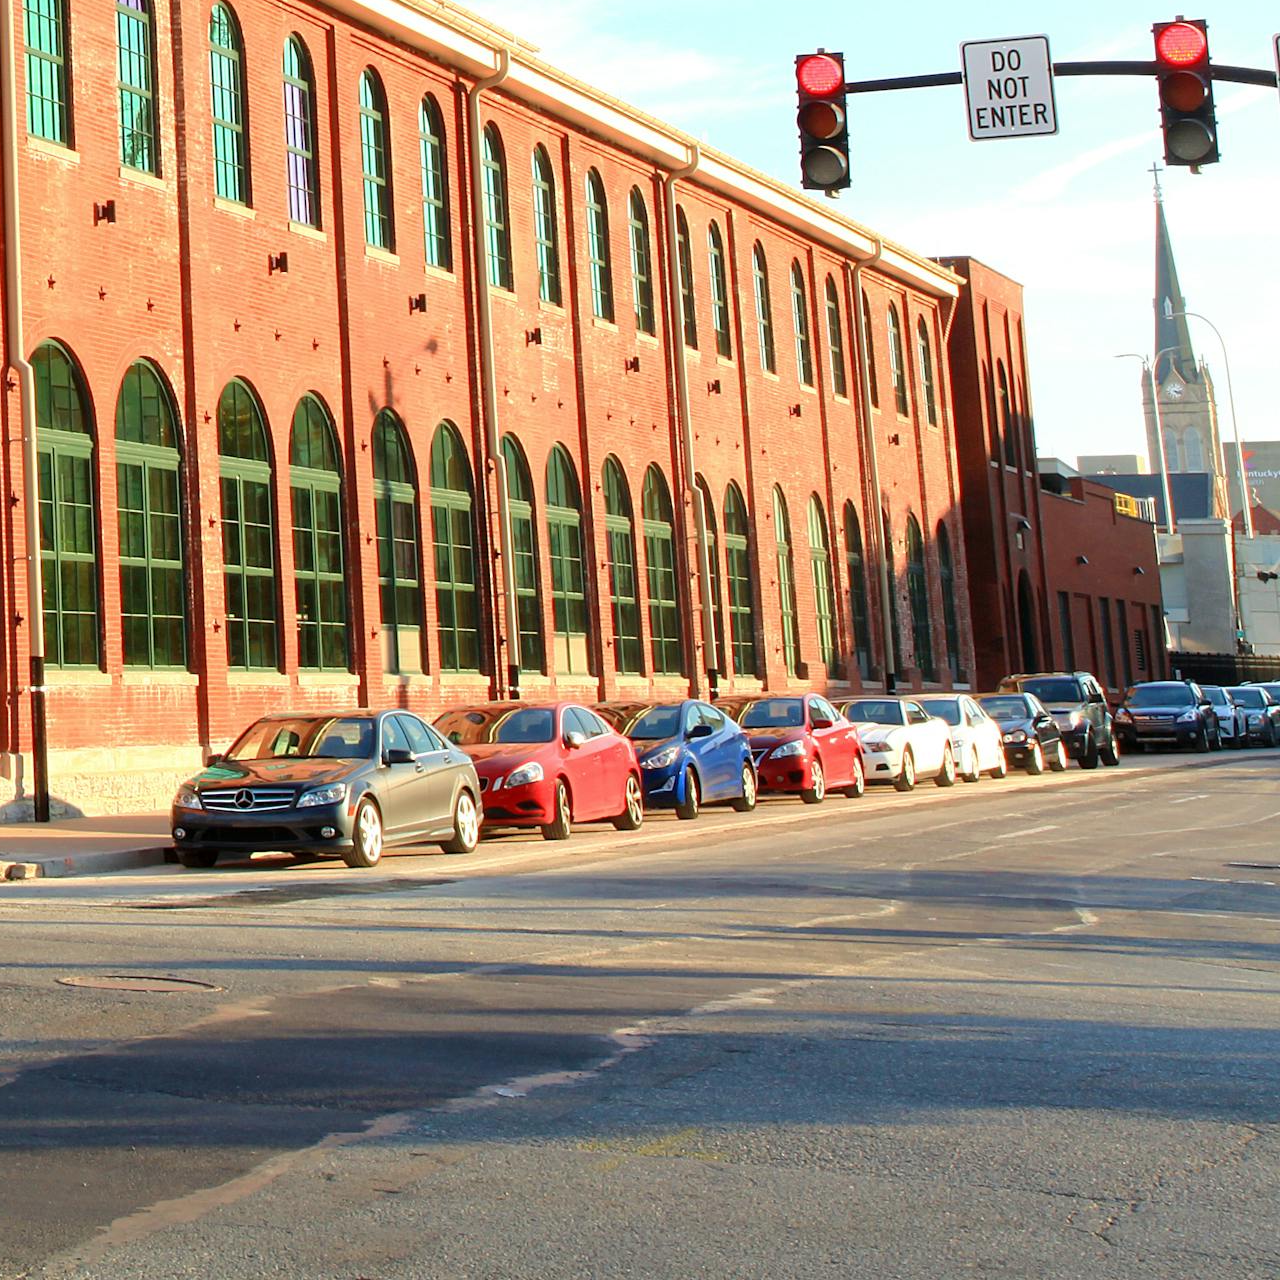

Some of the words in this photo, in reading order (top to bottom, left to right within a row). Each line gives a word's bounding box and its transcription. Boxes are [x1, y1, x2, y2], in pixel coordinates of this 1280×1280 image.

[991, 49, 1021, 72] DO
[987, 76, 1029, 100] NOT
[976, 103, 1048, 129] ENTER
